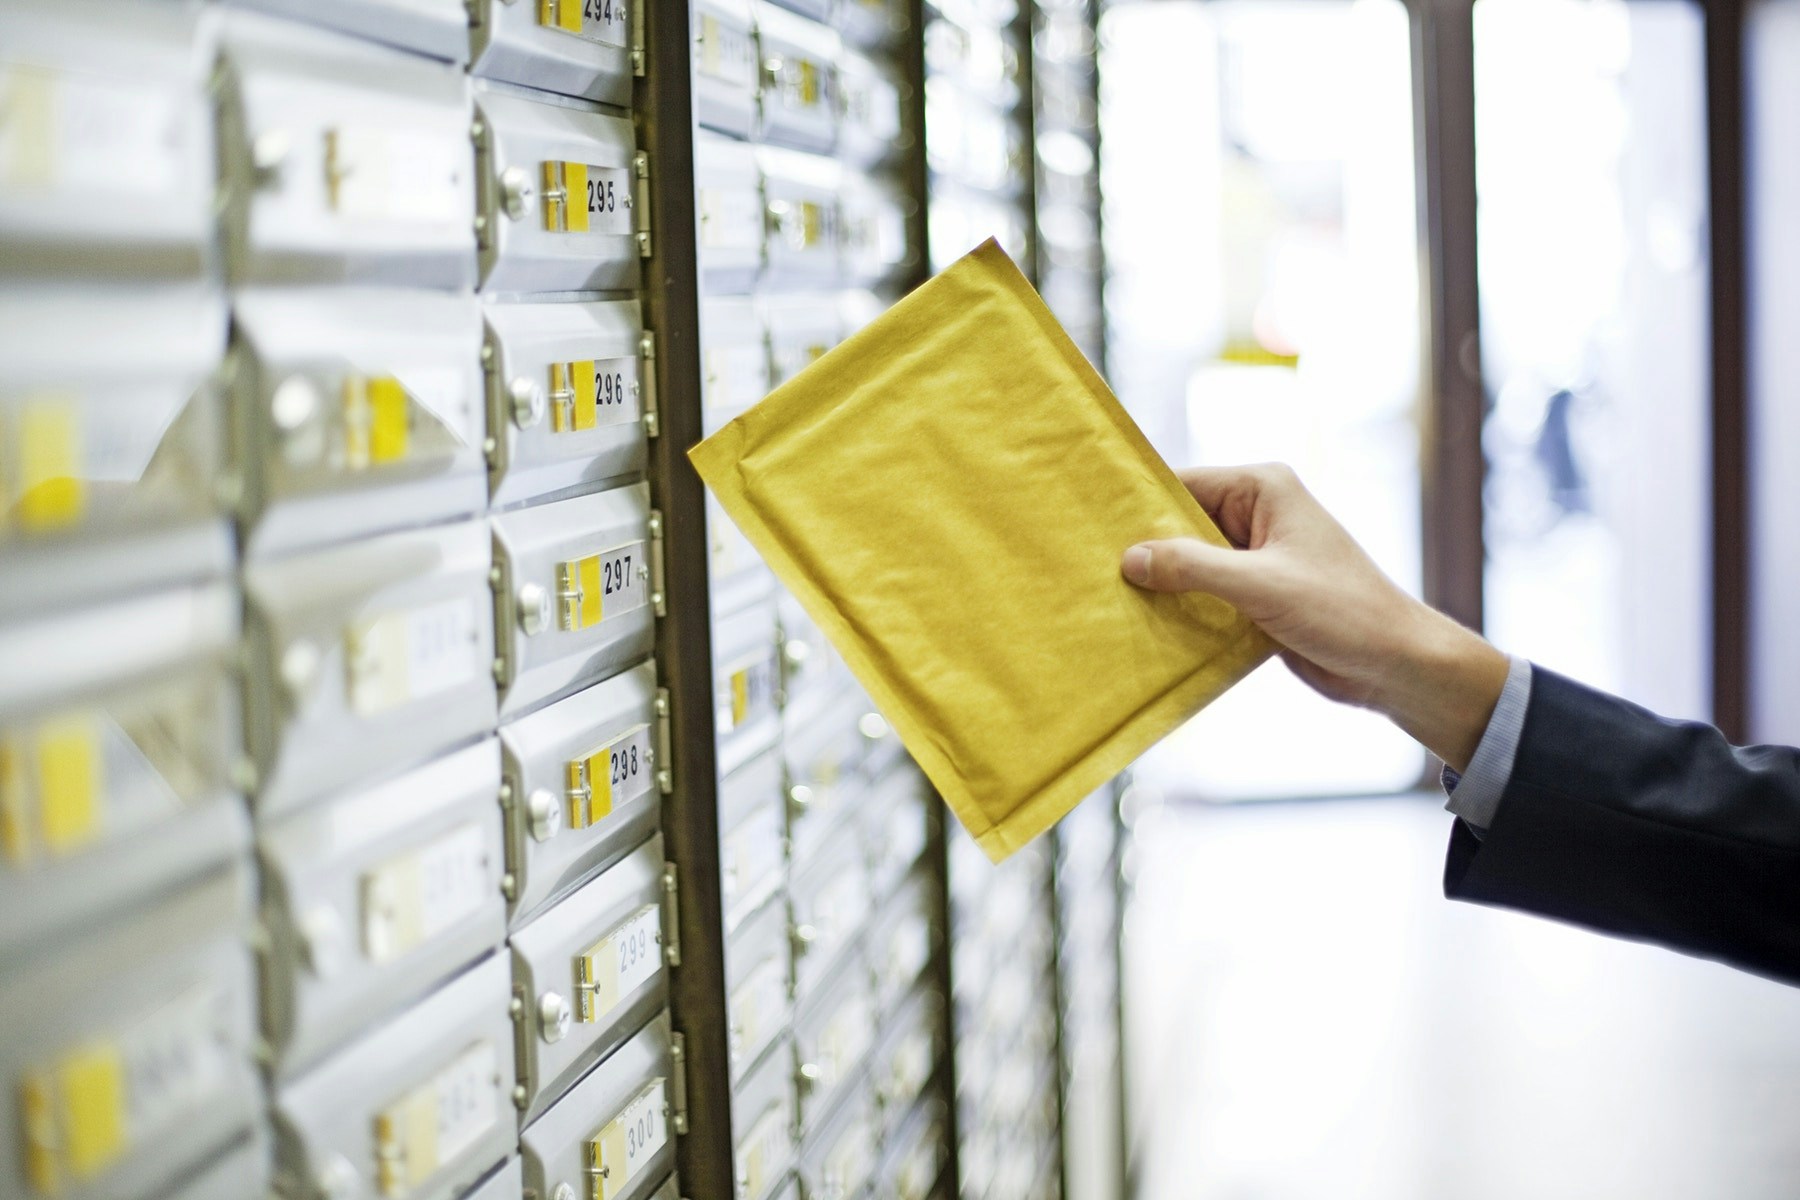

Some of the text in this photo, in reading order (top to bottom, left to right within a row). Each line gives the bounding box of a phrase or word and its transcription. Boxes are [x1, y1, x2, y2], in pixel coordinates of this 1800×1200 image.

[587, 179, 615, 213] 295
[595, 372, 623, 405] 296
[604, 555, 631, 595] 297
[611, 744, 638, 785] 298
[620, 928, 646, 973] 299
[628, 1109, 654, 1158] 300
